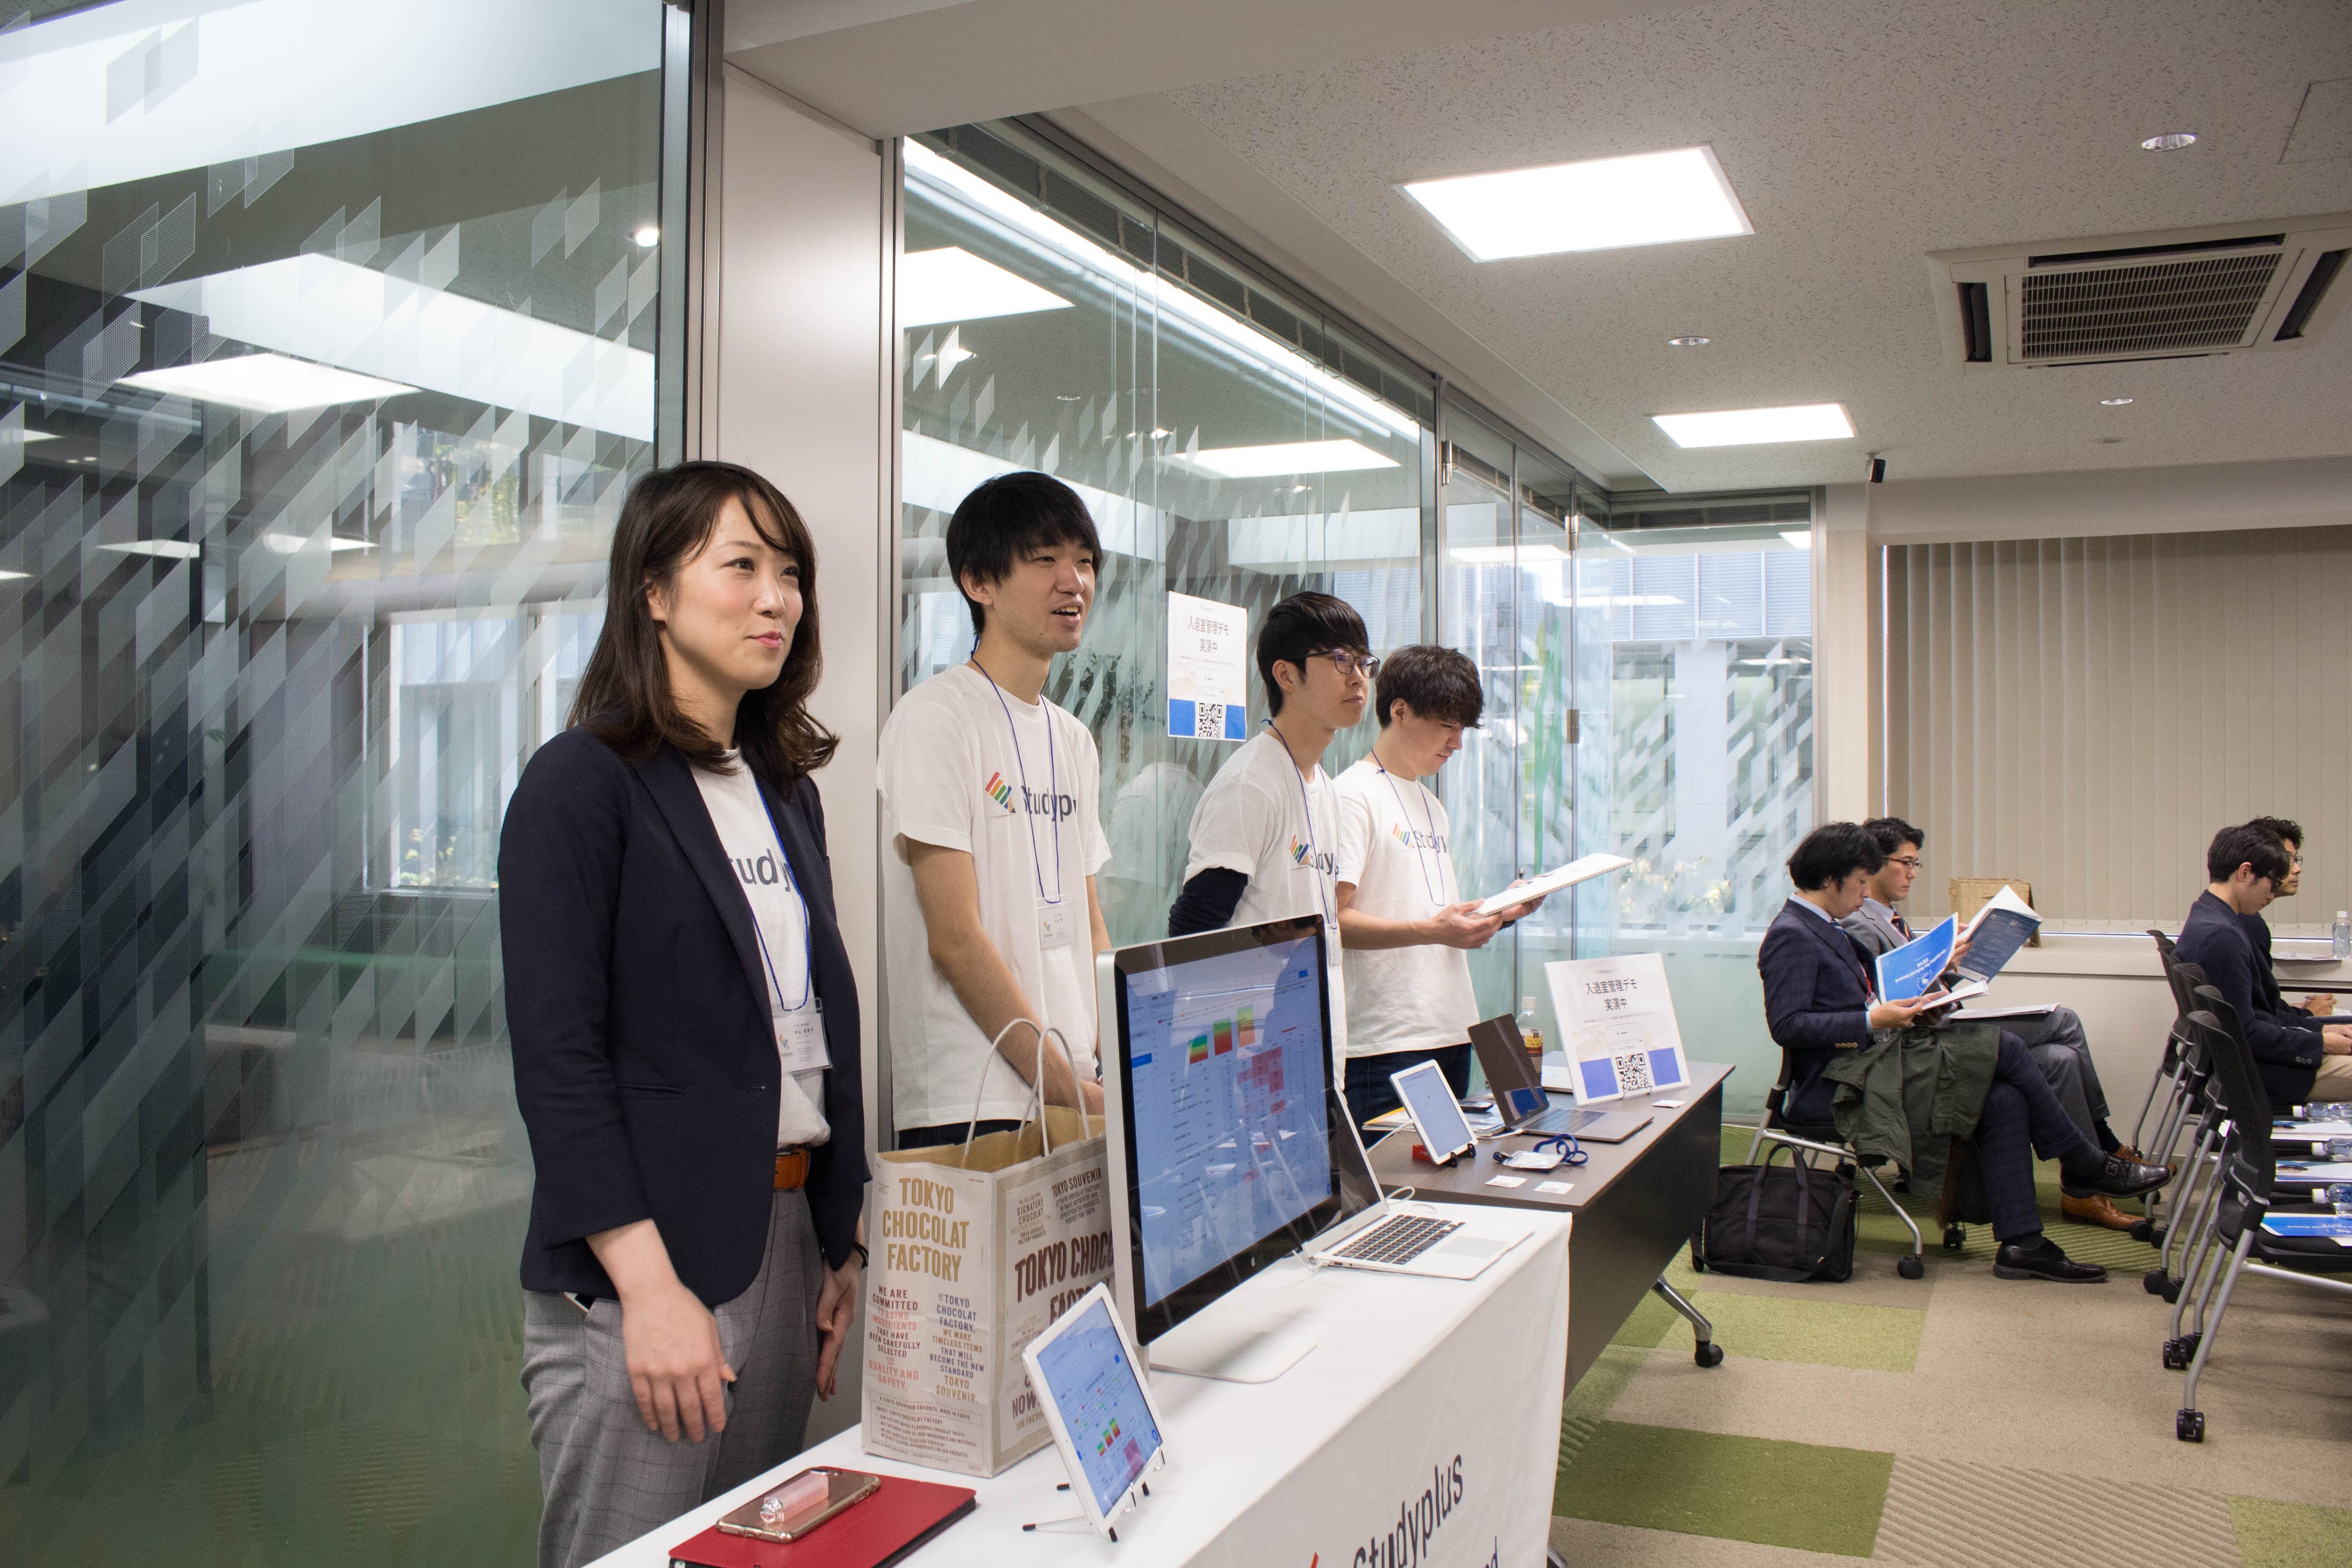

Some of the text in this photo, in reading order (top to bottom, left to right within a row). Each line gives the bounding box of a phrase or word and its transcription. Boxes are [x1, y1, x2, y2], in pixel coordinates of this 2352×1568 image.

[1188, 616, 1229, 635] 入退室管理デモ
[1200, 638, 1217, 653] 実演中
[1586, 978, 1637, 995] 入退室管理デモ
[1604, 996, 1627, 1011] 実演中
[1052, 1167, 1102, 1199] TOKYO SOUVENIR
[899, 1178, 954, 1214] TOKYO
[1017, 1197, 1044, 1216] SIGNATURE
[1019, 1207, 1043, 1225] CHOCOLAT
[883, 1210, 969, 1249] CHOCOLAT
[888, 1243, 961, 1282] FACTORY
[1015, 1241, 1067, 1303] TOKYO
[879, 1285, 908, 1299] WE ARE
[873, 1293, 918, 1310] COMMITTED
[945, 1294, 969, 1308] TOKYO
[885, 1310, 909, 1320] USING
[937, 1304, 976, 1322] CHOCOLAT
[873, 1314, 917, 1331] INGREDIENTS
[940, 1317, 975, 1333] FACTORY,
[870, 1332, 921, 1349] BEEN CAREFULLY
[877, 1326, 909, 1340] THAT HAVE
[943, 1329, 971, 1341] WE MAKE
[878, 1344, 906, 1358] SELECTED
[932, 1336, 982, 1353] TIMELESS ITEMS
[941, 1347, 973, 1361] THAT WILL
[869, 1360, 919, 1380] QUALITY AND
[930, 1354, 984, 1372] BECOME THE NEW
[940, 1365, 973, 1379] STANDARD
[878, 1374, 907, 1390] SAFETY.
[945, 1375, 969, 1389] TOKYO
[936, 1385, 978, 1404] SOUVENIR.
[883, 1397, 895, 1405] TOKYO
[896, 1401, 915, 1410] SOUVENIR
[876, 1405, 888, 1413] ABOUT
[901, 1413, 922, 1422] CHOCOLAT
